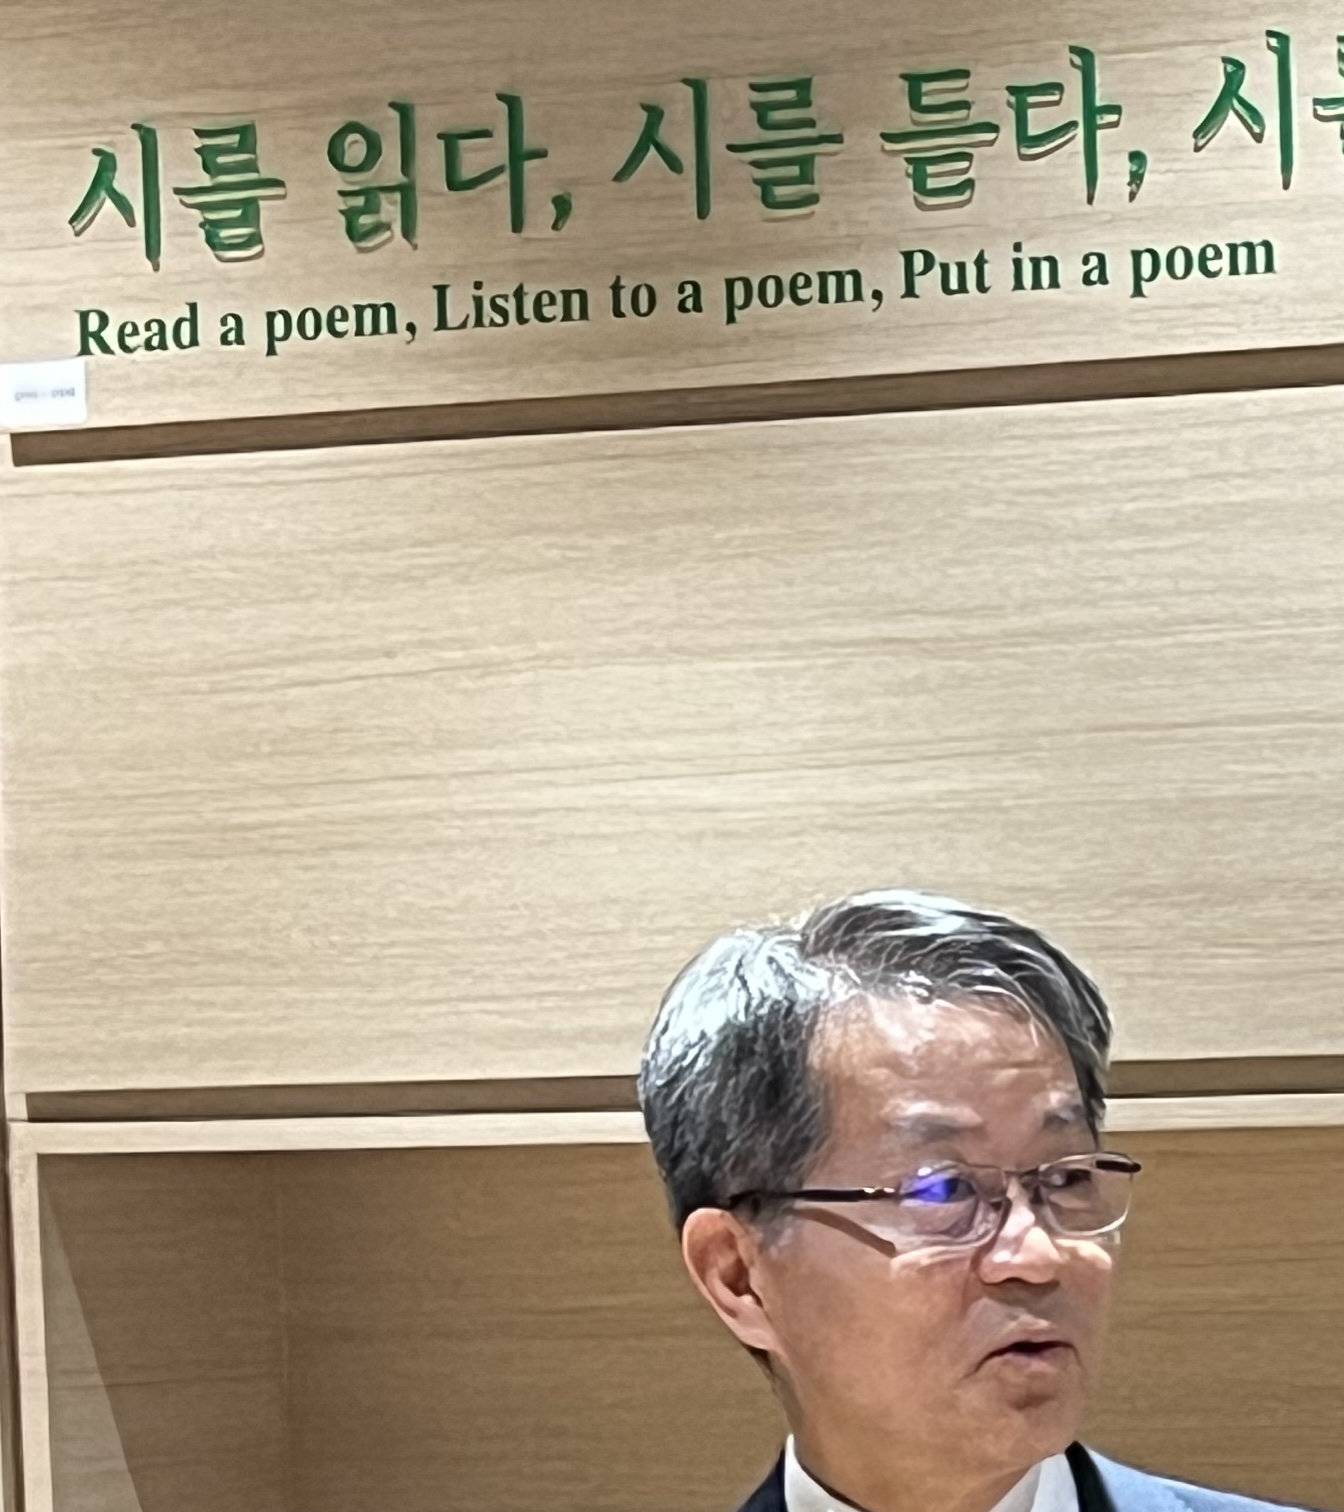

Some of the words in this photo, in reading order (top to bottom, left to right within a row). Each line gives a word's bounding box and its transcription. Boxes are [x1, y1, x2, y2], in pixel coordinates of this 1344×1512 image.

[69, 121, 287, 272] 시를
[325, 92, 573, 252] 읽다,
[611, 77, 845, 219] 시를
[879, 44, 1151, 209] 듣다,
[76, 302, 201, 357] Read
[218, 313, 247, 347] a
[264, 303, 419, 356] poem,
[431, 279, 590, 334] Listen
[608, 278, 656, 321] to
[675, 280, 704, 313] a
[722, 270, 885, 325] poem,
[899, 247, 991, 299] Put
[1010, 241, 1061, 291] in
[1081, 252, 1110, 287] a
[1129, 239, 1277, 297] poem
